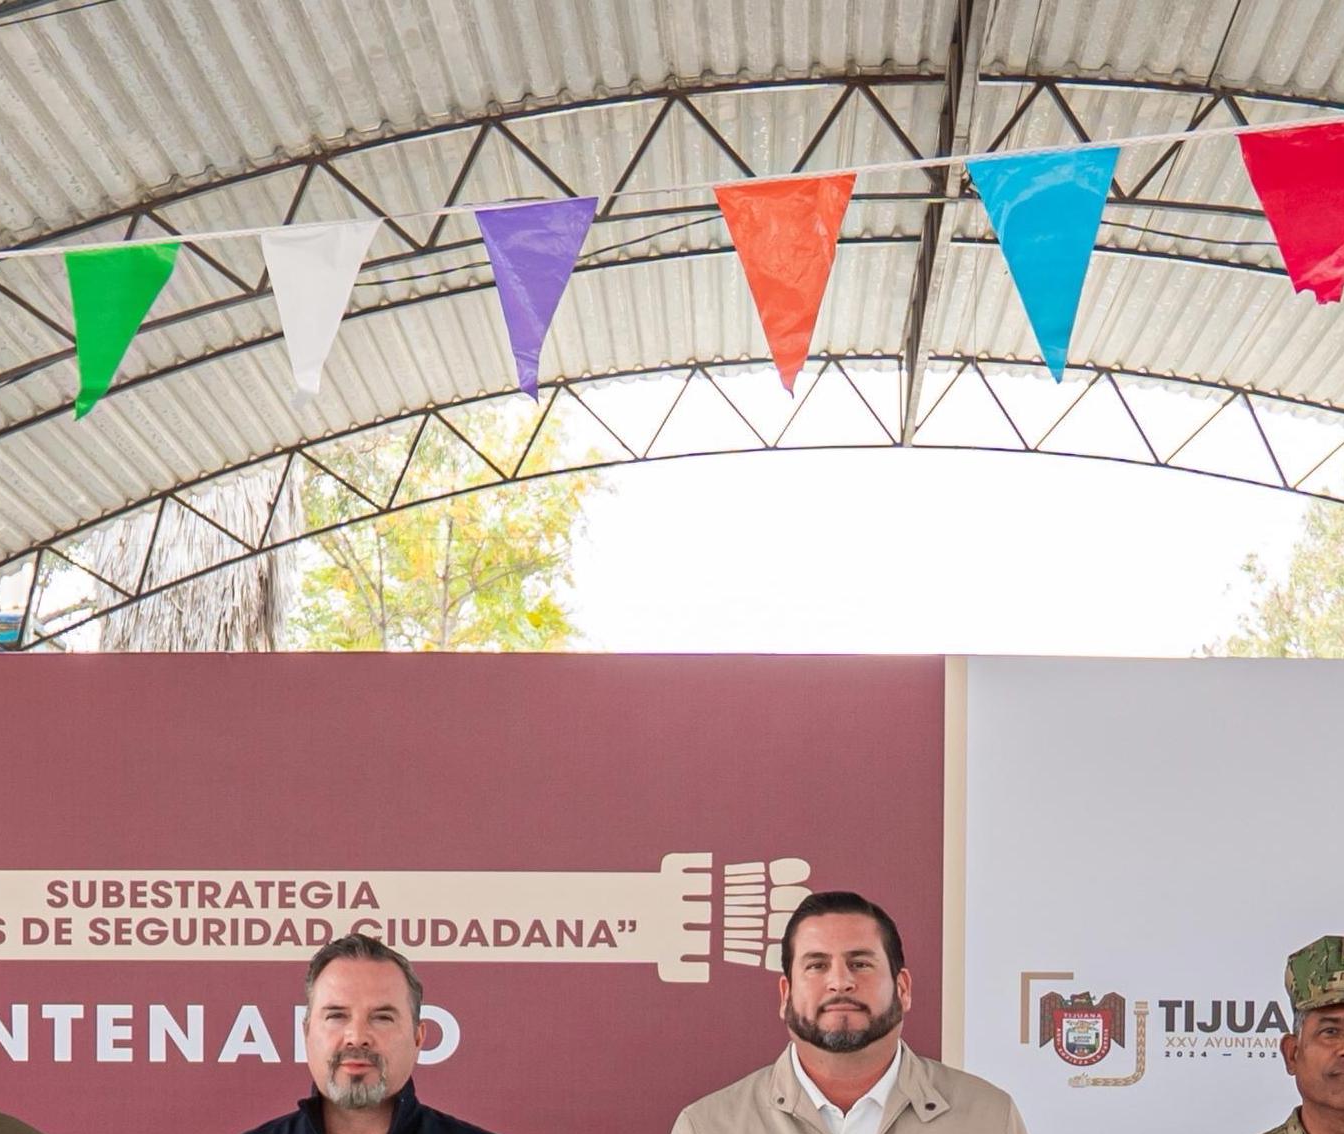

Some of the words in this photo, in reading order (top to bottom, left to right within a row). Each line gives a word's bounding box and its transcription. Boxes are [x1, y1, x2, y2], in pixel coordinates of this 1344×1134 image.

[46, 880, 380, 909] SUBESTRATEGIA
[22, 917, 72, 946] DE
[89, 917, 333, 947] SEGURIDAD
[1158, 1000, 1290, 1033] TIJUA
[1165, 1036, 1198, 1048] XXV
[1204, 1036, 1278, 1049] AYUNTAM
